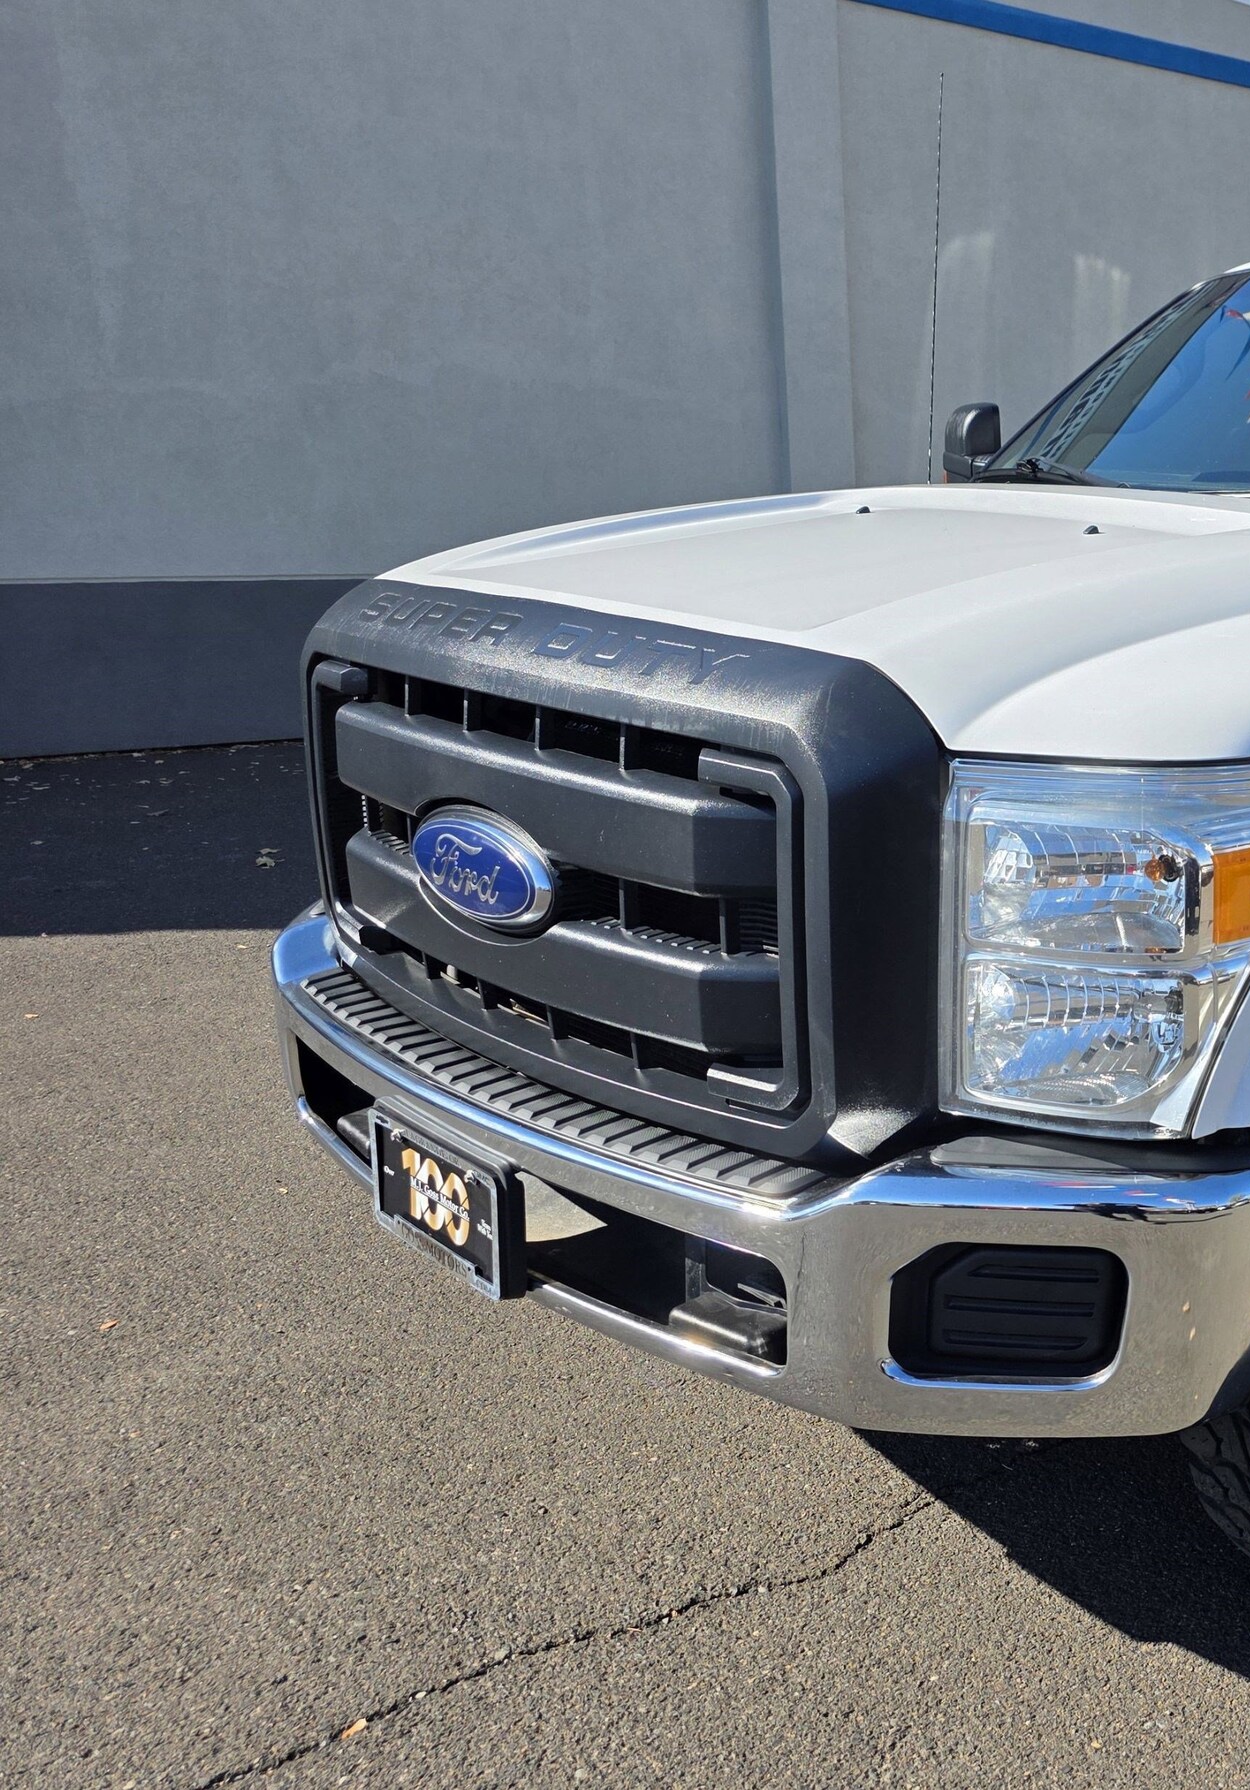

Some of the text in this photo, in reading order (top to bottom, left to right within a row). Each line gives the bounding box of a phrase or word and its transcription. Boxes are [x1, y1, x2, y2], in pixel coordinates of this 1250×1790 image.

[358, 592, 751, 685] SUPER DUTY
[430, 833, 501, 905] Ford
[402, 1148, 470, 1246] 100
